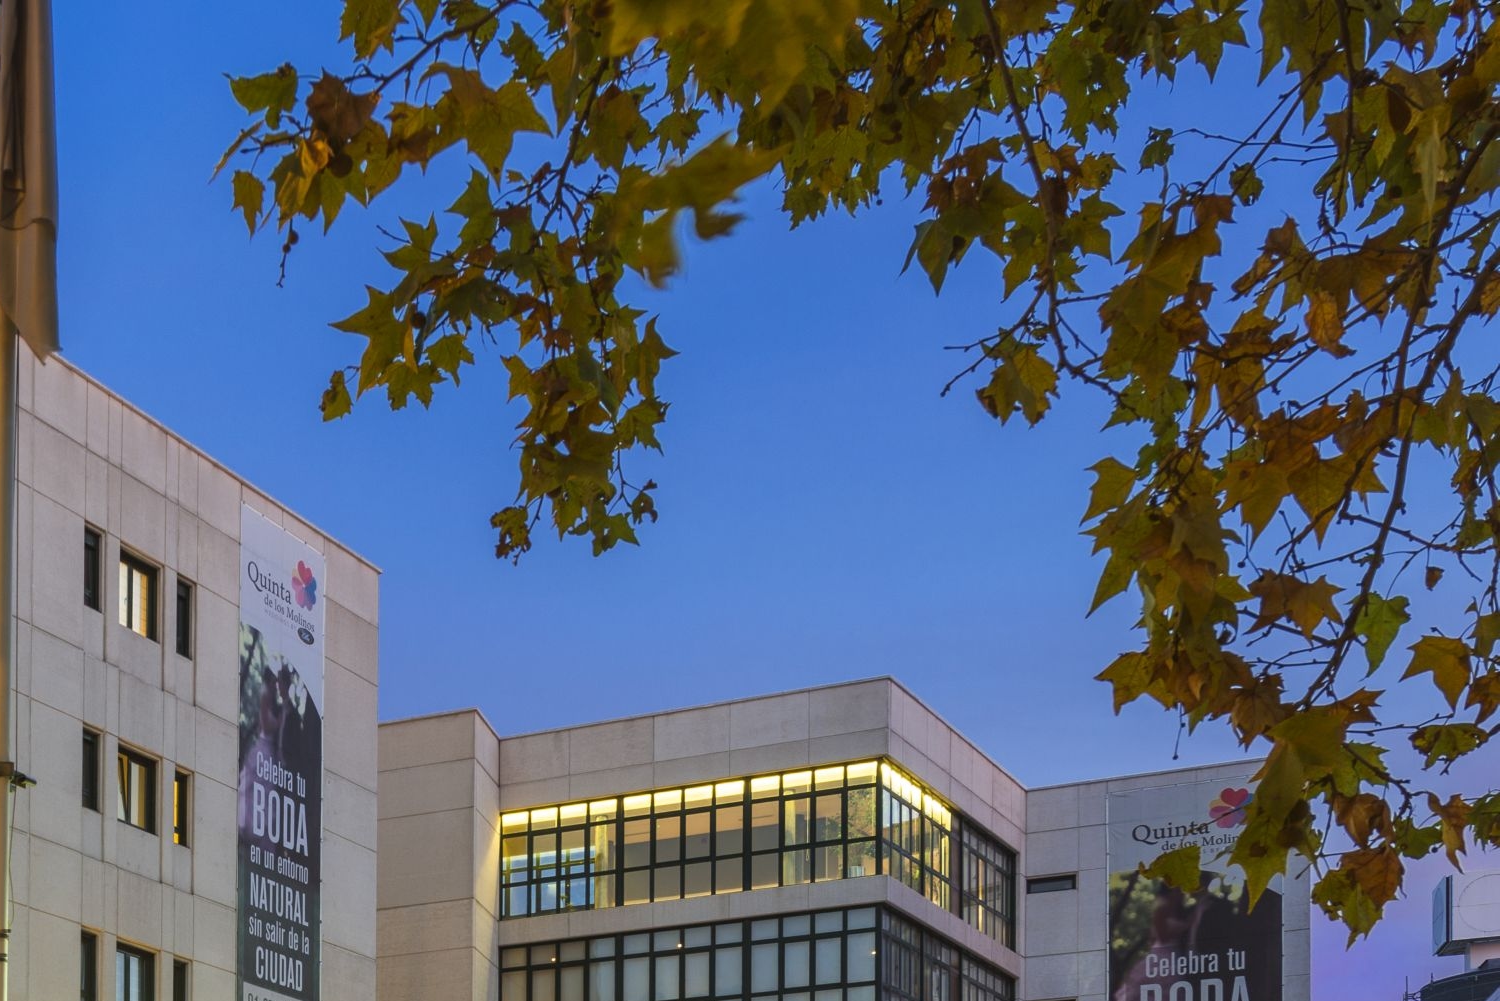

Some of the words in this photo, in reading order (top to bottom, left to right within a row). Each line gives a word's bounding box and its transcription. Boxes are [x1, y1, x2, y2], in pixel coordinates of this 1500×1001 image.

[247, 561, 292, 604] Quinta
[264, 594, 273, 608] de
[275, 599, 284, 615] los
[286, 607, 315, 632] Molinos
[256, 751, 293, 790] Celebra
[296, 772, 306, 797] tu
[253, 782, 309, 857] BODA
[1131, 821, 1210, 845] Quinta
[250, 844, 261, 866] en
[263, 850, 275, 870] un
[277, 855, 309, 885] entorno
[1161, 841, 1176, 851] de
[250, 871, 309, 927] NATURAL
[248, 915, 262, 938] sin
[265, 919, 284, 946] salir
[288, 928, 299, 951] de
[301, 935, 310, 955] la
[255, 946, 303, 992] CIUDAD
[1145, 950, 1219, 978] Celebra
[1227, 948, 1246, 971] tu
